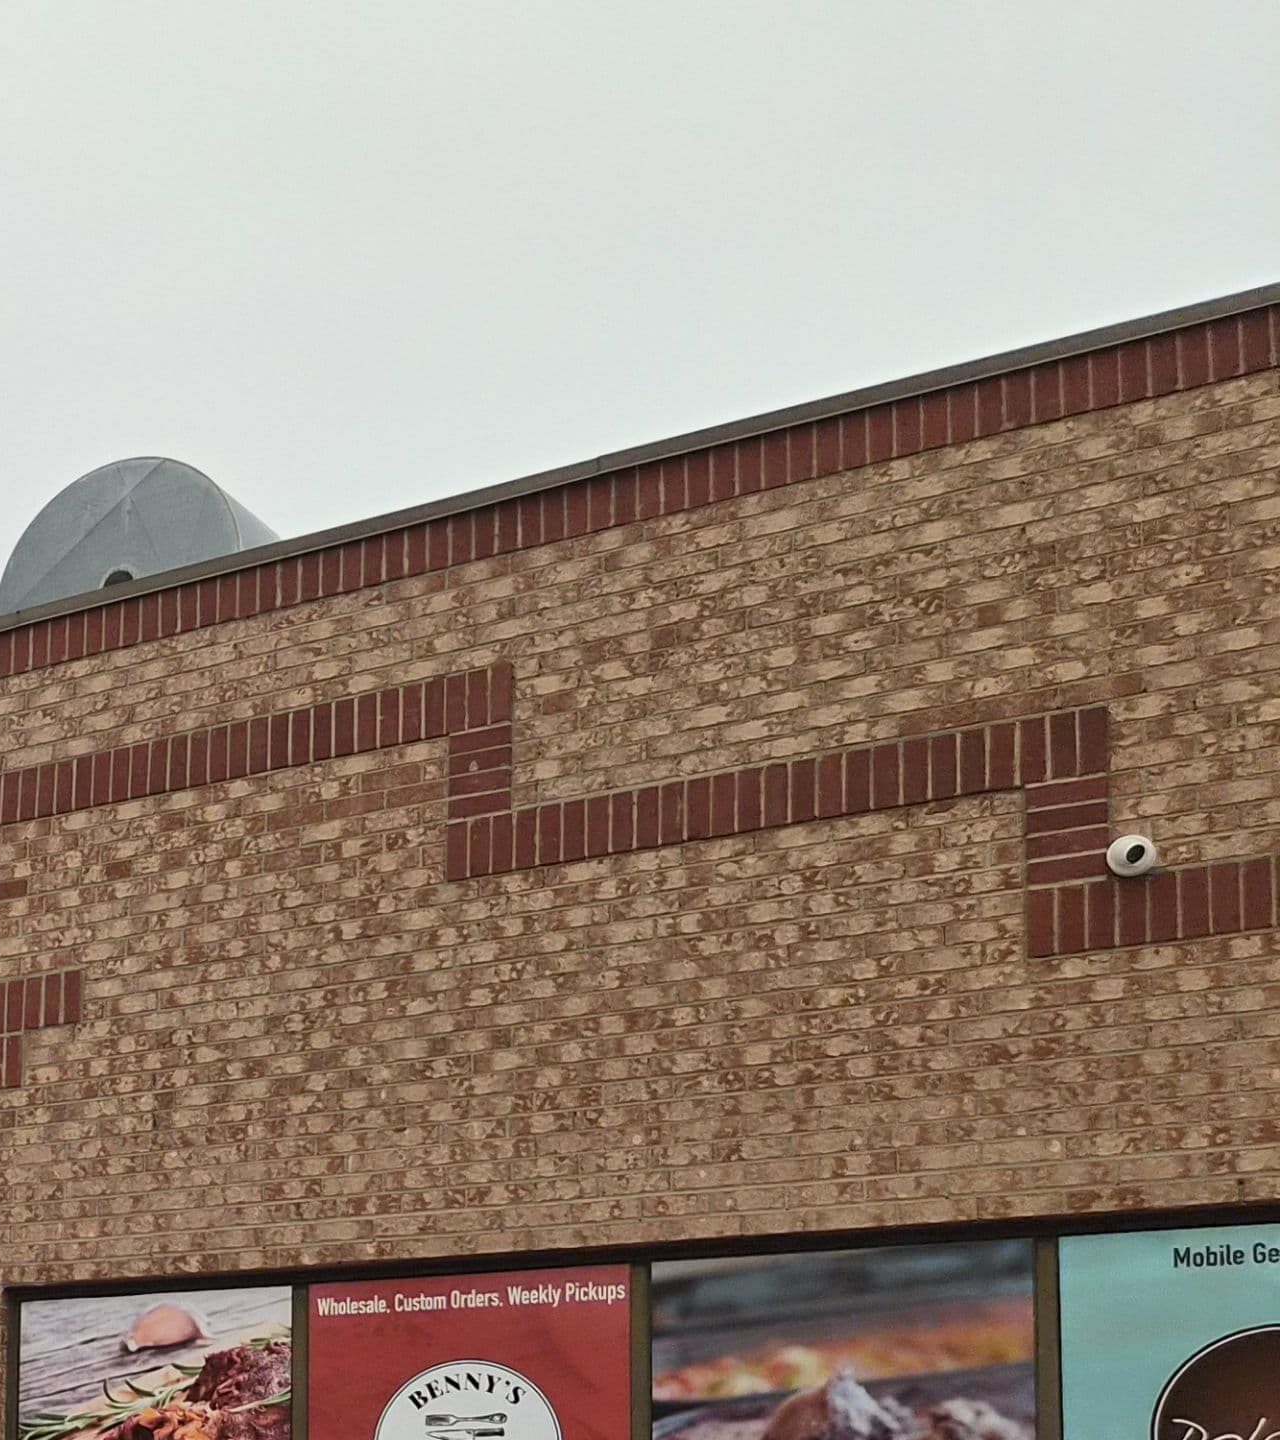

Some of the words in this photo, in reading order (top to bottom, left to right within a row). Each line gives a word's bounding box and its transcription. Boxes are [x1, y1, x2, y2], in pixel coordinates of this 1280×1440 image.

[1173, 1244, 1245, 1269] Mobile
[395, 1293, 447, 1313] Custom
[507, 1284, 561, 1307] Weekly
[565, 1282, 626, 1304] Pickups
[408, 1372, 527, 1410] BENNY'S
